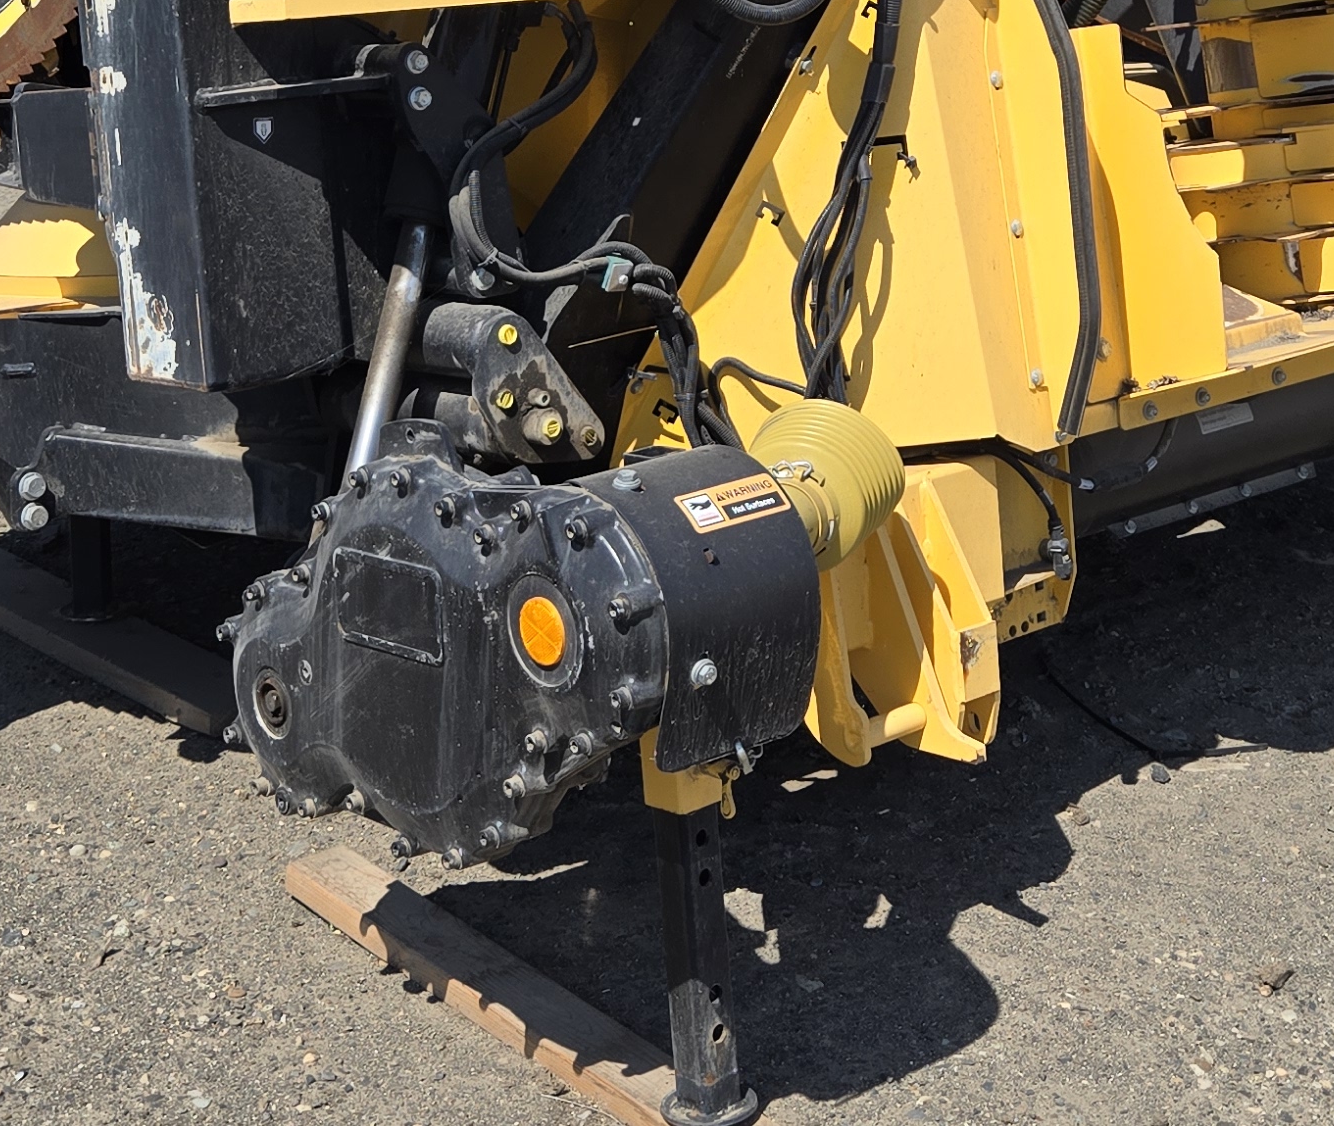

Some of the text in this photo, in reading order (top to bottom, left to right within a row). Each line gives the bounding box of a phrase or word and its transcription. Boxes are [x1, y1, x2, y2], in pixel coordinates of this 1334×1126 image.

[722, 479, 773, 499] WARNING
[731, 497, 776, 515] Hot Surfaces
